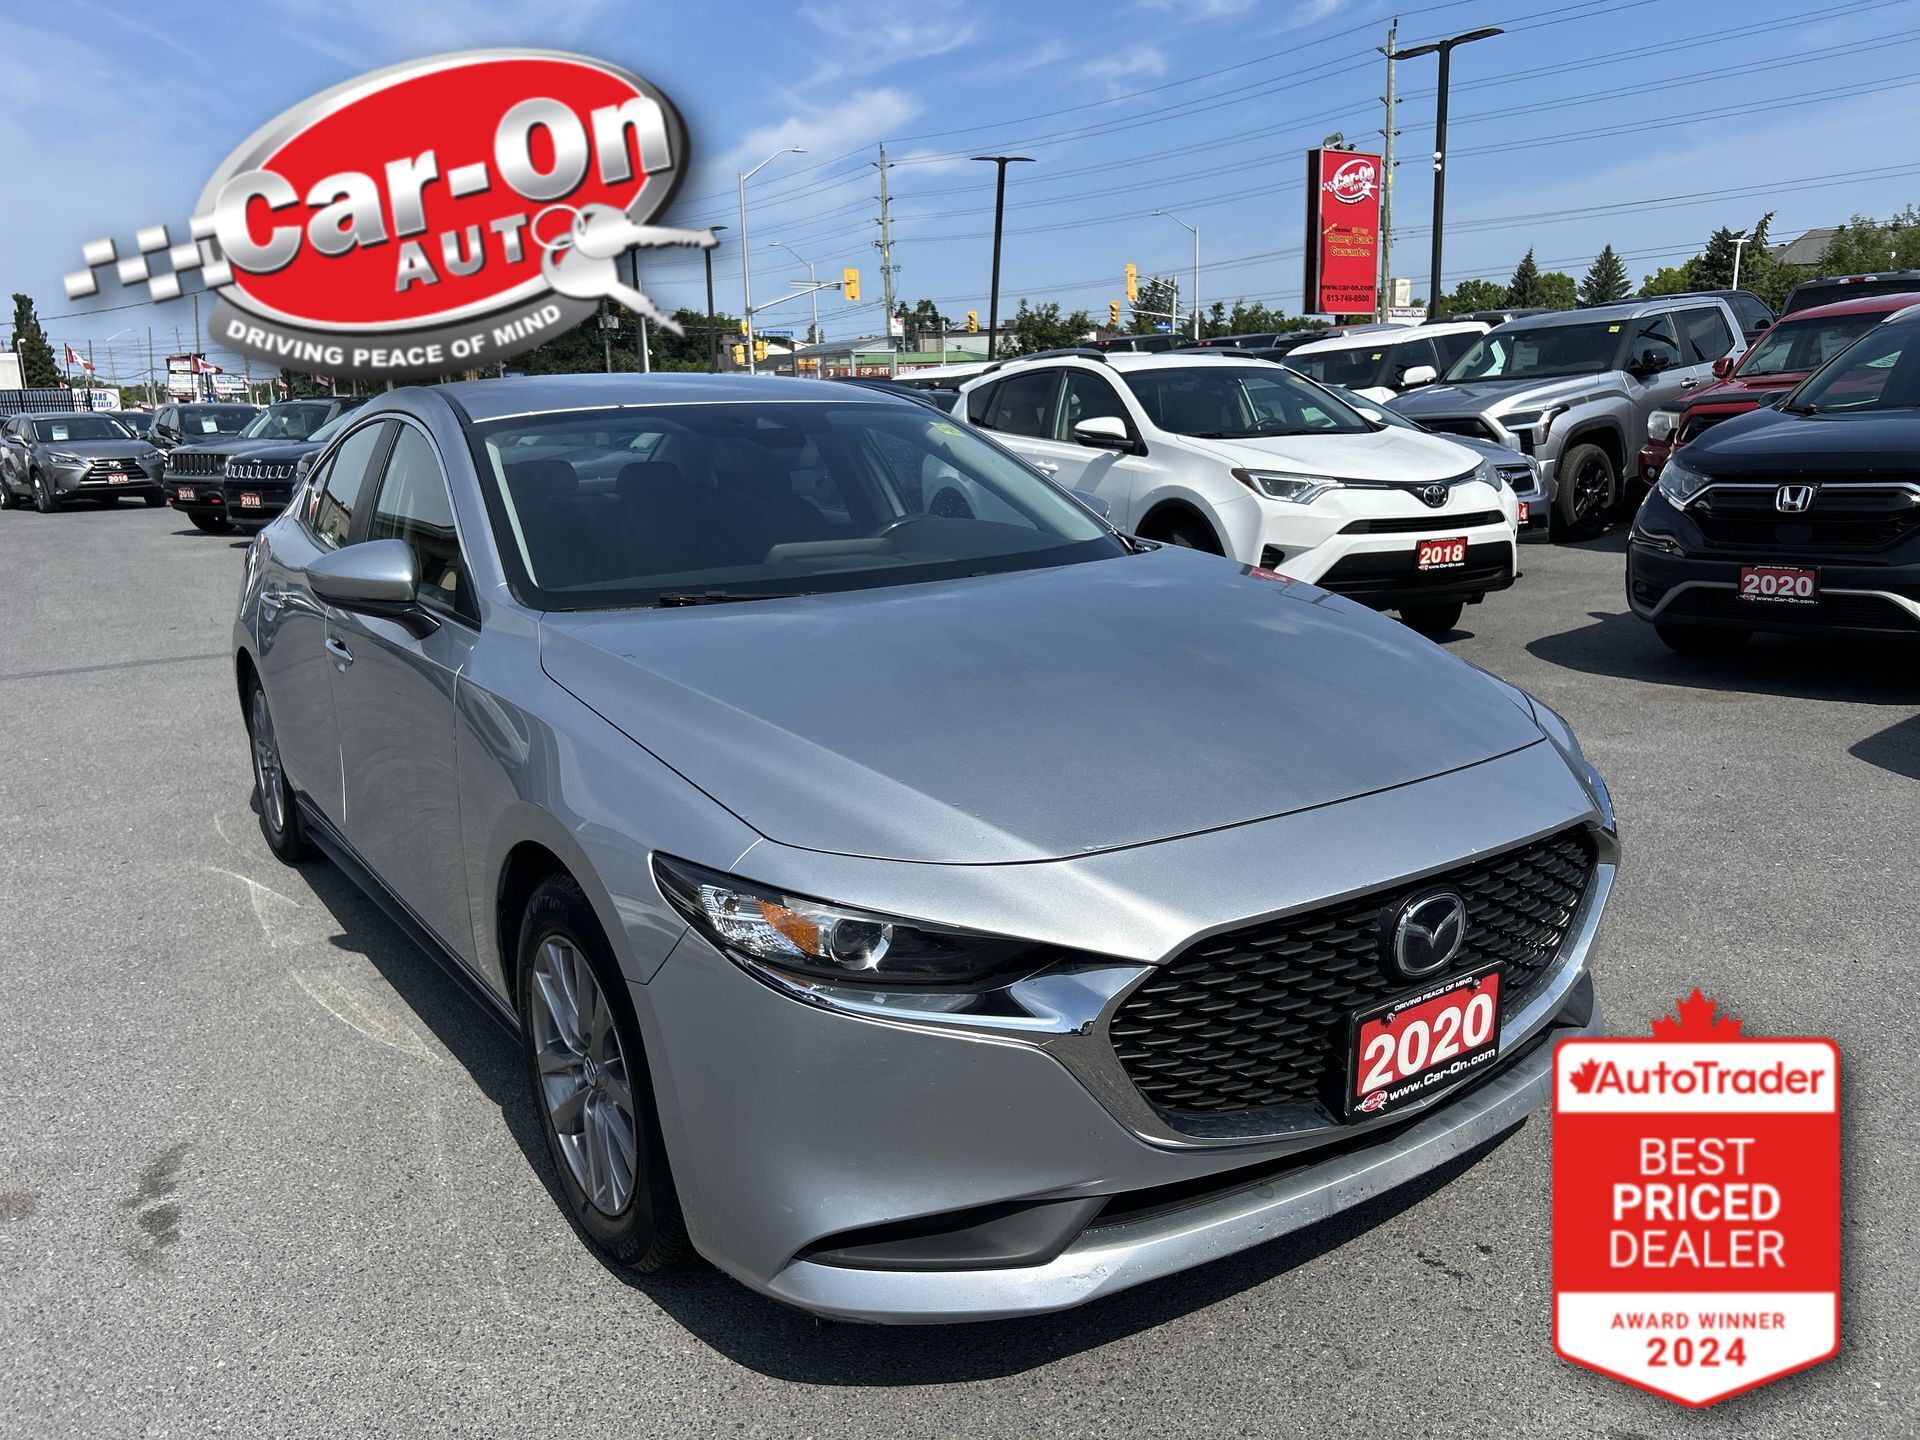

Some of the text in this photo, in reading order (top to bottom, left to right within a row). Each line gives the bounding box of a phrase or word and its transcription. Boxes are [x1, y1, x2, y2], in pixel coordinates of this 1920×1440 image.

[1327, 233, 1374, 246] Money Back
[1330, 246, 1370, 257] Guarantee
[241, 496, 260, 506] 2018
[1420, 544, 1463, 565] 2018
[1744, 574, 1813, 597] 2020
[1756, 596, 1815, 604] www.Car-On.com
[1394, 976, 1473, 1012] DRIVING PEACE OF MIND
[1361, 993, 1493, 1094] 2020
[1389, 1048, 1496, 1101] www.Car-On.com
